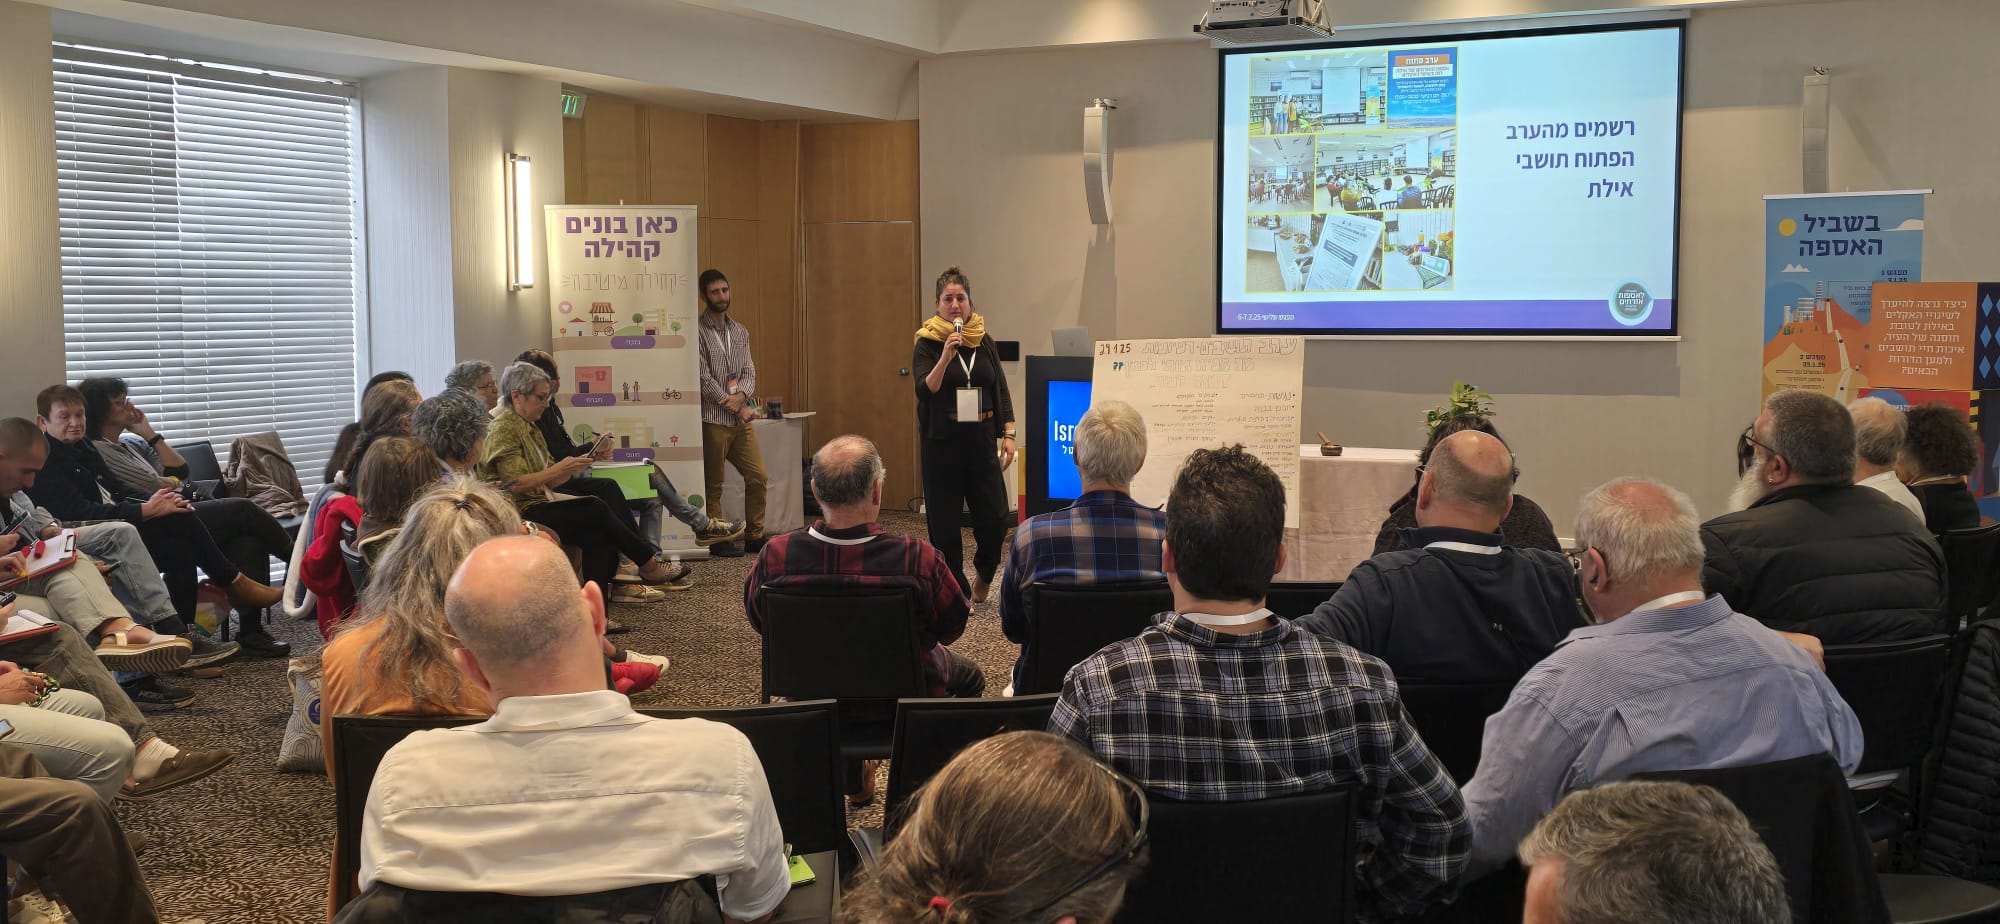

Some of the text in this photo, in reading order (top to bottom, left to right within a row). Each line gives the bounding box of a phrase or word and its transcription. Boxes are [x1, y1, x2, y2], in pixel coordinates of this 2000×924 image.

[1506, 120, 1635, 139] רשמים מהערב
[1516, 150, 1635, 169] הפתוח תושבי
[1587, 178, 1633, 198] אילת
[565, 216, 678, 237] כאן בונים
[1803, 213, 1880, 233] בשביל
[584, 237, 661, 261] קהילה
[1799, 238, 1883, 256] האספה
[1618, 292, 1645, 300] לאספות
[1880, 299, 1967, 310] כיצד נרצה להיערך
[1886, 310, 1961, 320] לשינויי האקלים
[1889, 321, 1921, 330] לטובת
[1911, 332, 1927, 342] של
[1929, 334, 1960, 342] חוסנה
[1920, 345, 1934, 353] חיי
[1936, 345, 1965, 354] איכות
[1888, 355, 1952, 365] ולמען הדורות
[1901, 366, 1938, 376] הבאים?
[1054, 420, 1075, 442] Isr
